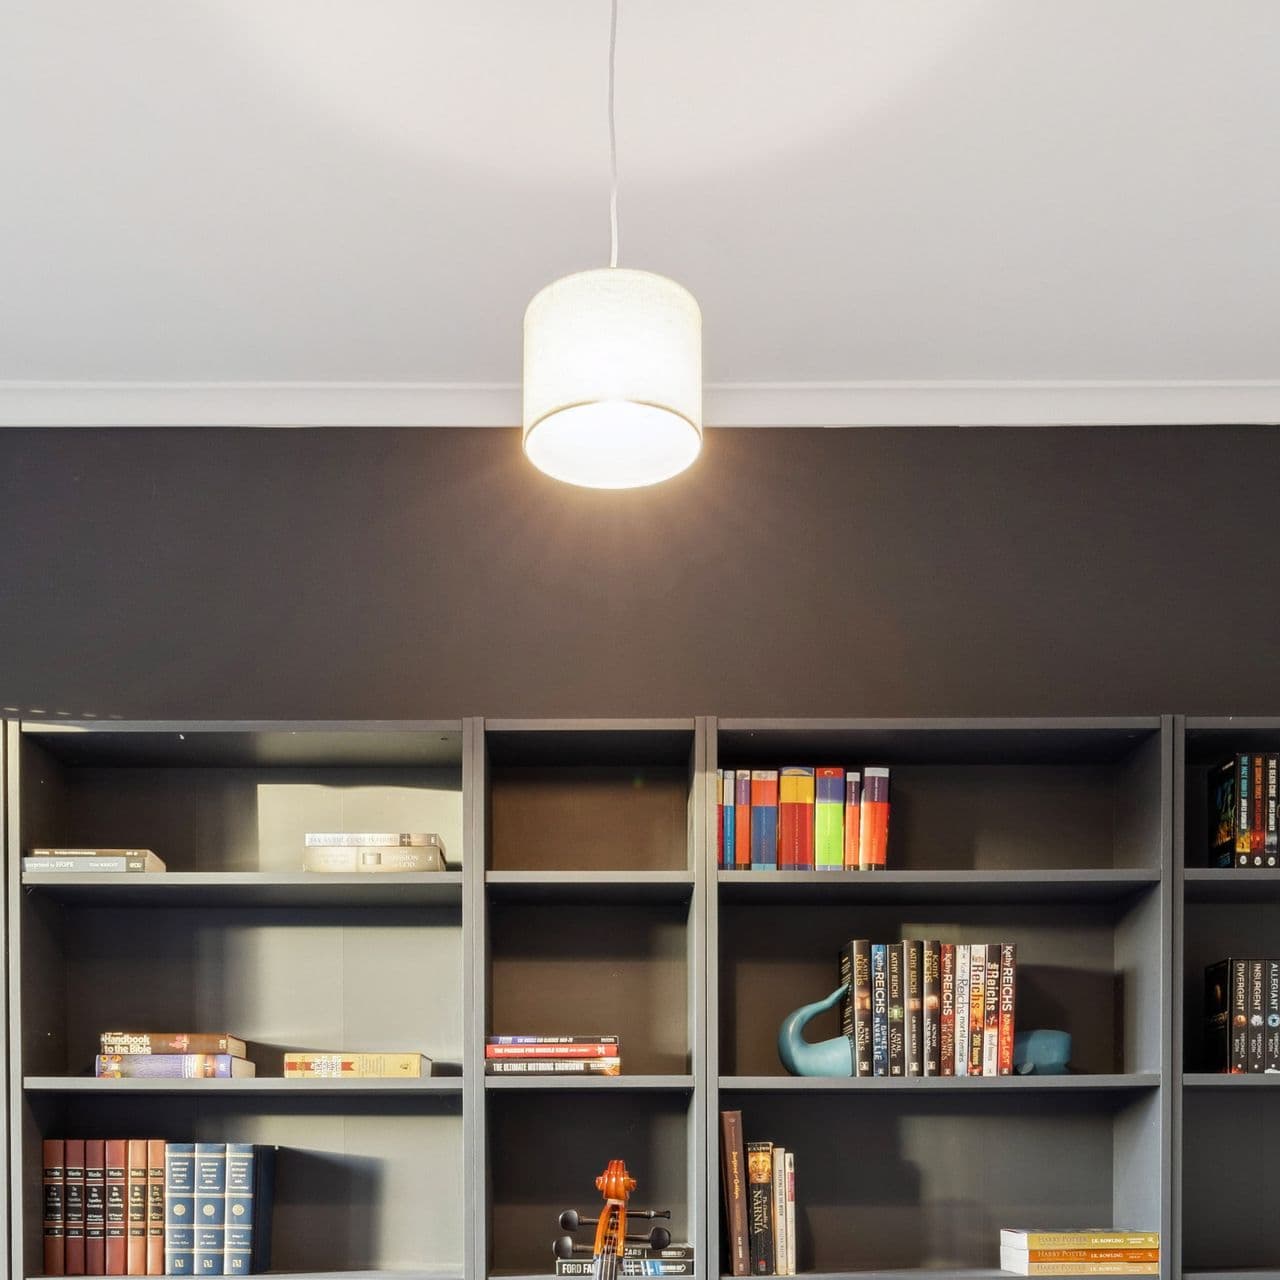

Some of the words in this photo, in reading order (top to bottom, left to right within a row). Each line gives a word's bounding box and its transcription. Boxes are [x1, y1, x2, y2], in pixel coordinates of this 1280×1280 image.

[875, 952, 884, 973] Kathy
[924, 950, 932, 984] REICHS
[943, 953, 952, 974] Kathy
[1003, 946, 1013, 967] Kathy
[875, 972, 885, 1014] REICHS
[943, 974, 952, 1016] REICHS
[971, 965, 984, 1009] Reichs
[986, 972, 998, 1011] Reichs
[1002, 968, 1013, 1011] REICHS
[1236, 963, 1245, 1011] DIVERGENT
[1253, 964, 1262, 1010] INSURGENT
[1270, 964, 1278, 1010] ALLEGIANT
[104, 1034, 150, 1046] Handbook
[104, 1045, 115, 1054] to
[115, 1045, 128, 1054] the
[129, 1045, 152, 1054] Bible
[753, 1190, 763, 1234] NARNIA
[562, 1264, 582, 1274] FORD
